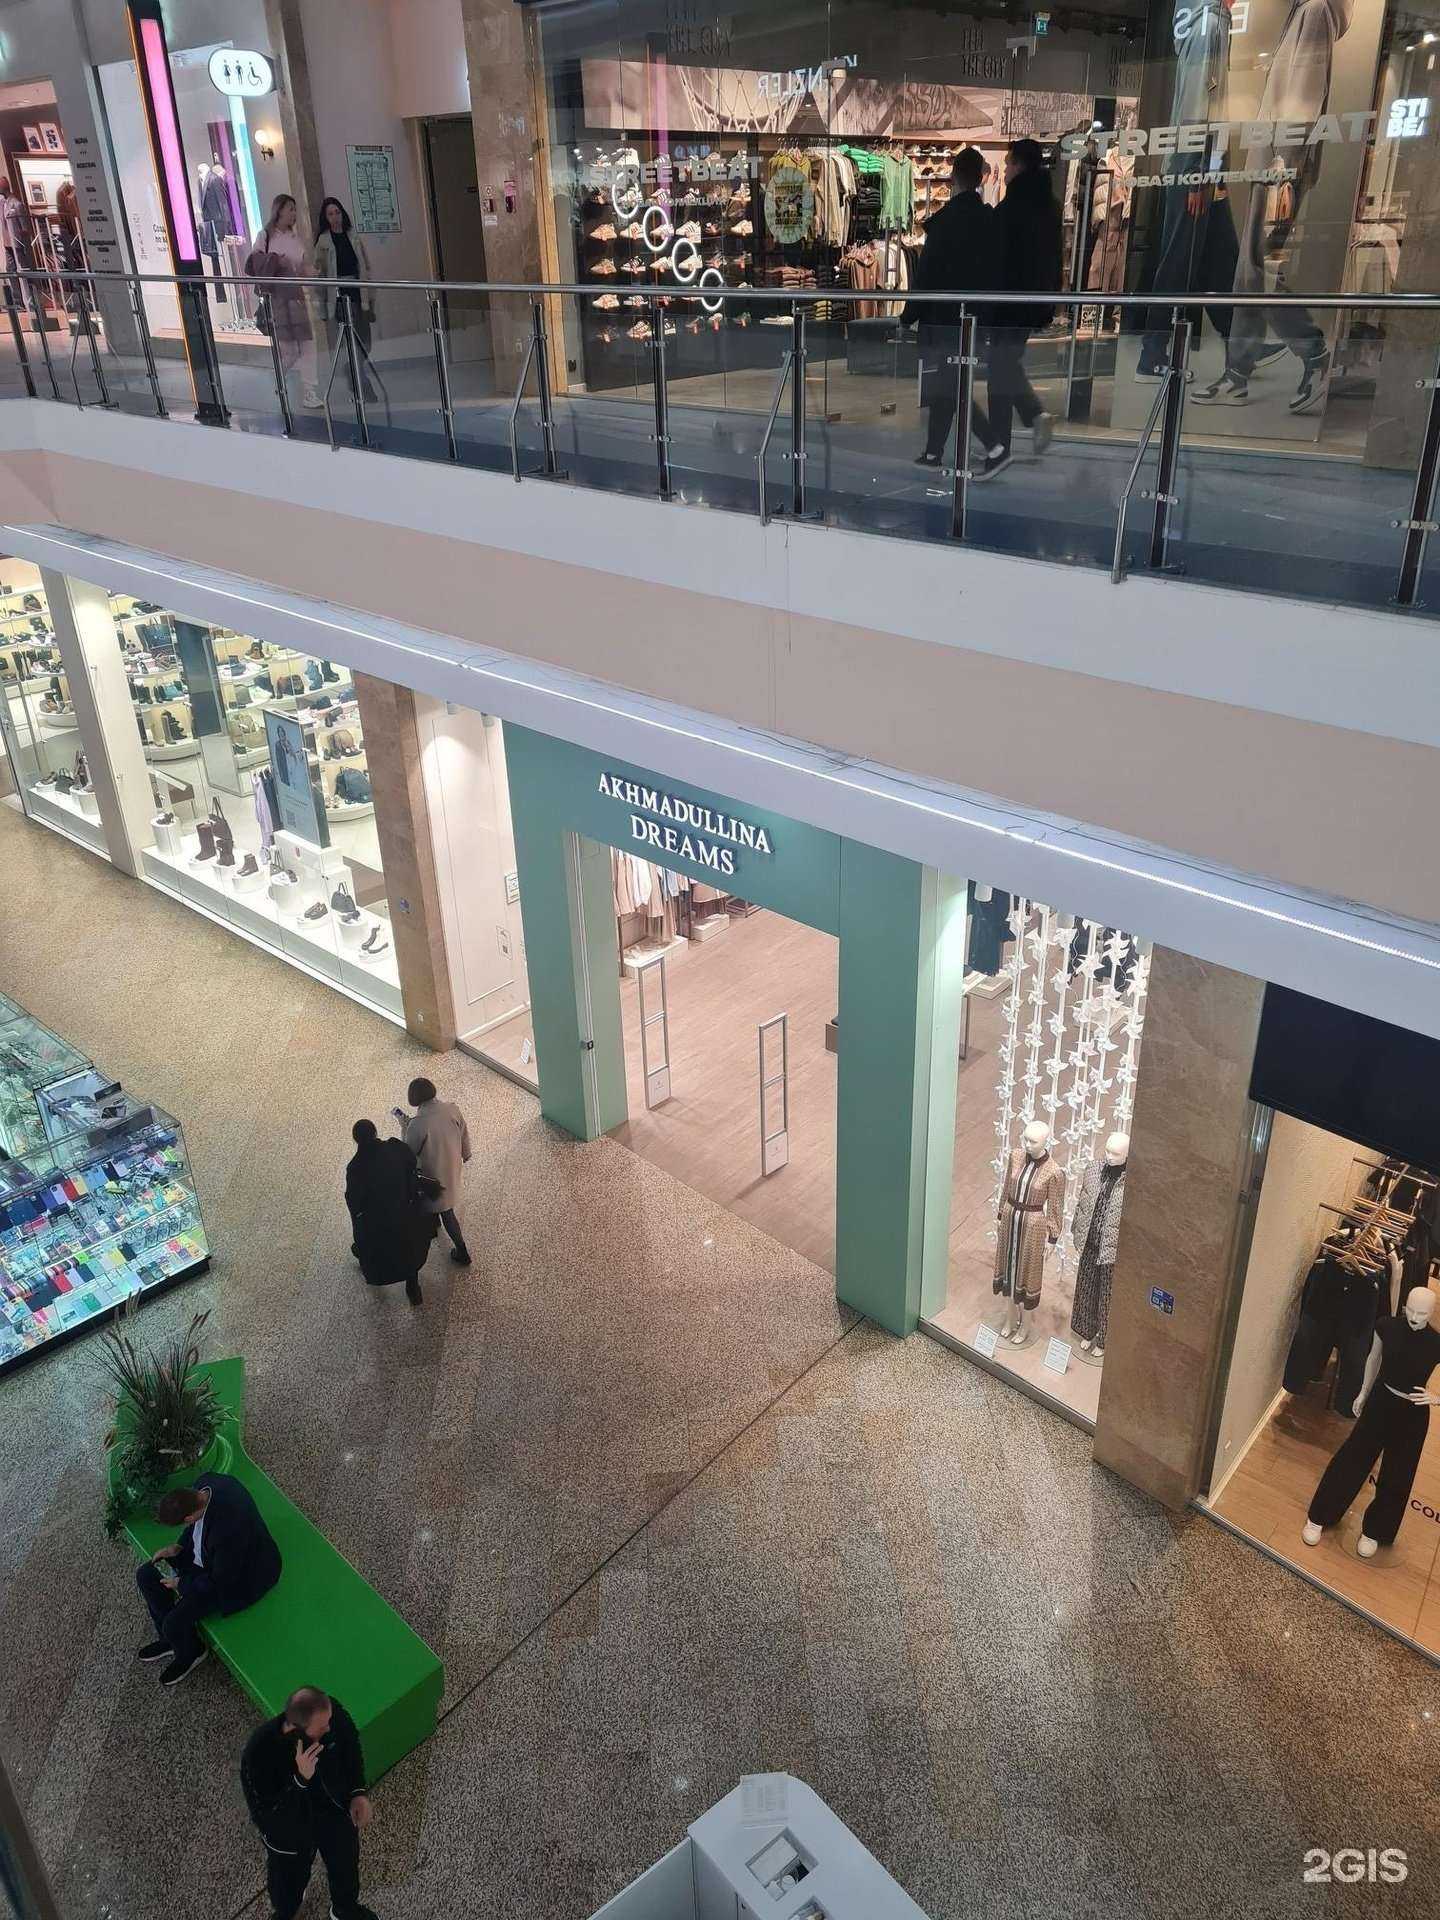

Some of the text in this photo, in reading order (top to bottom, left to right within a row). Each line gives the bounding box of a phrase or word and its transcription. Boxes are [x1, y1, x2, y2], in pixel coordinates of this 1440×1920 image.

[1116, 173, 1174, 188] ОВАЯ
[598, 773, 772, 854] AKHMADULLINA
[630, 814, 735, 875] DREAMS
